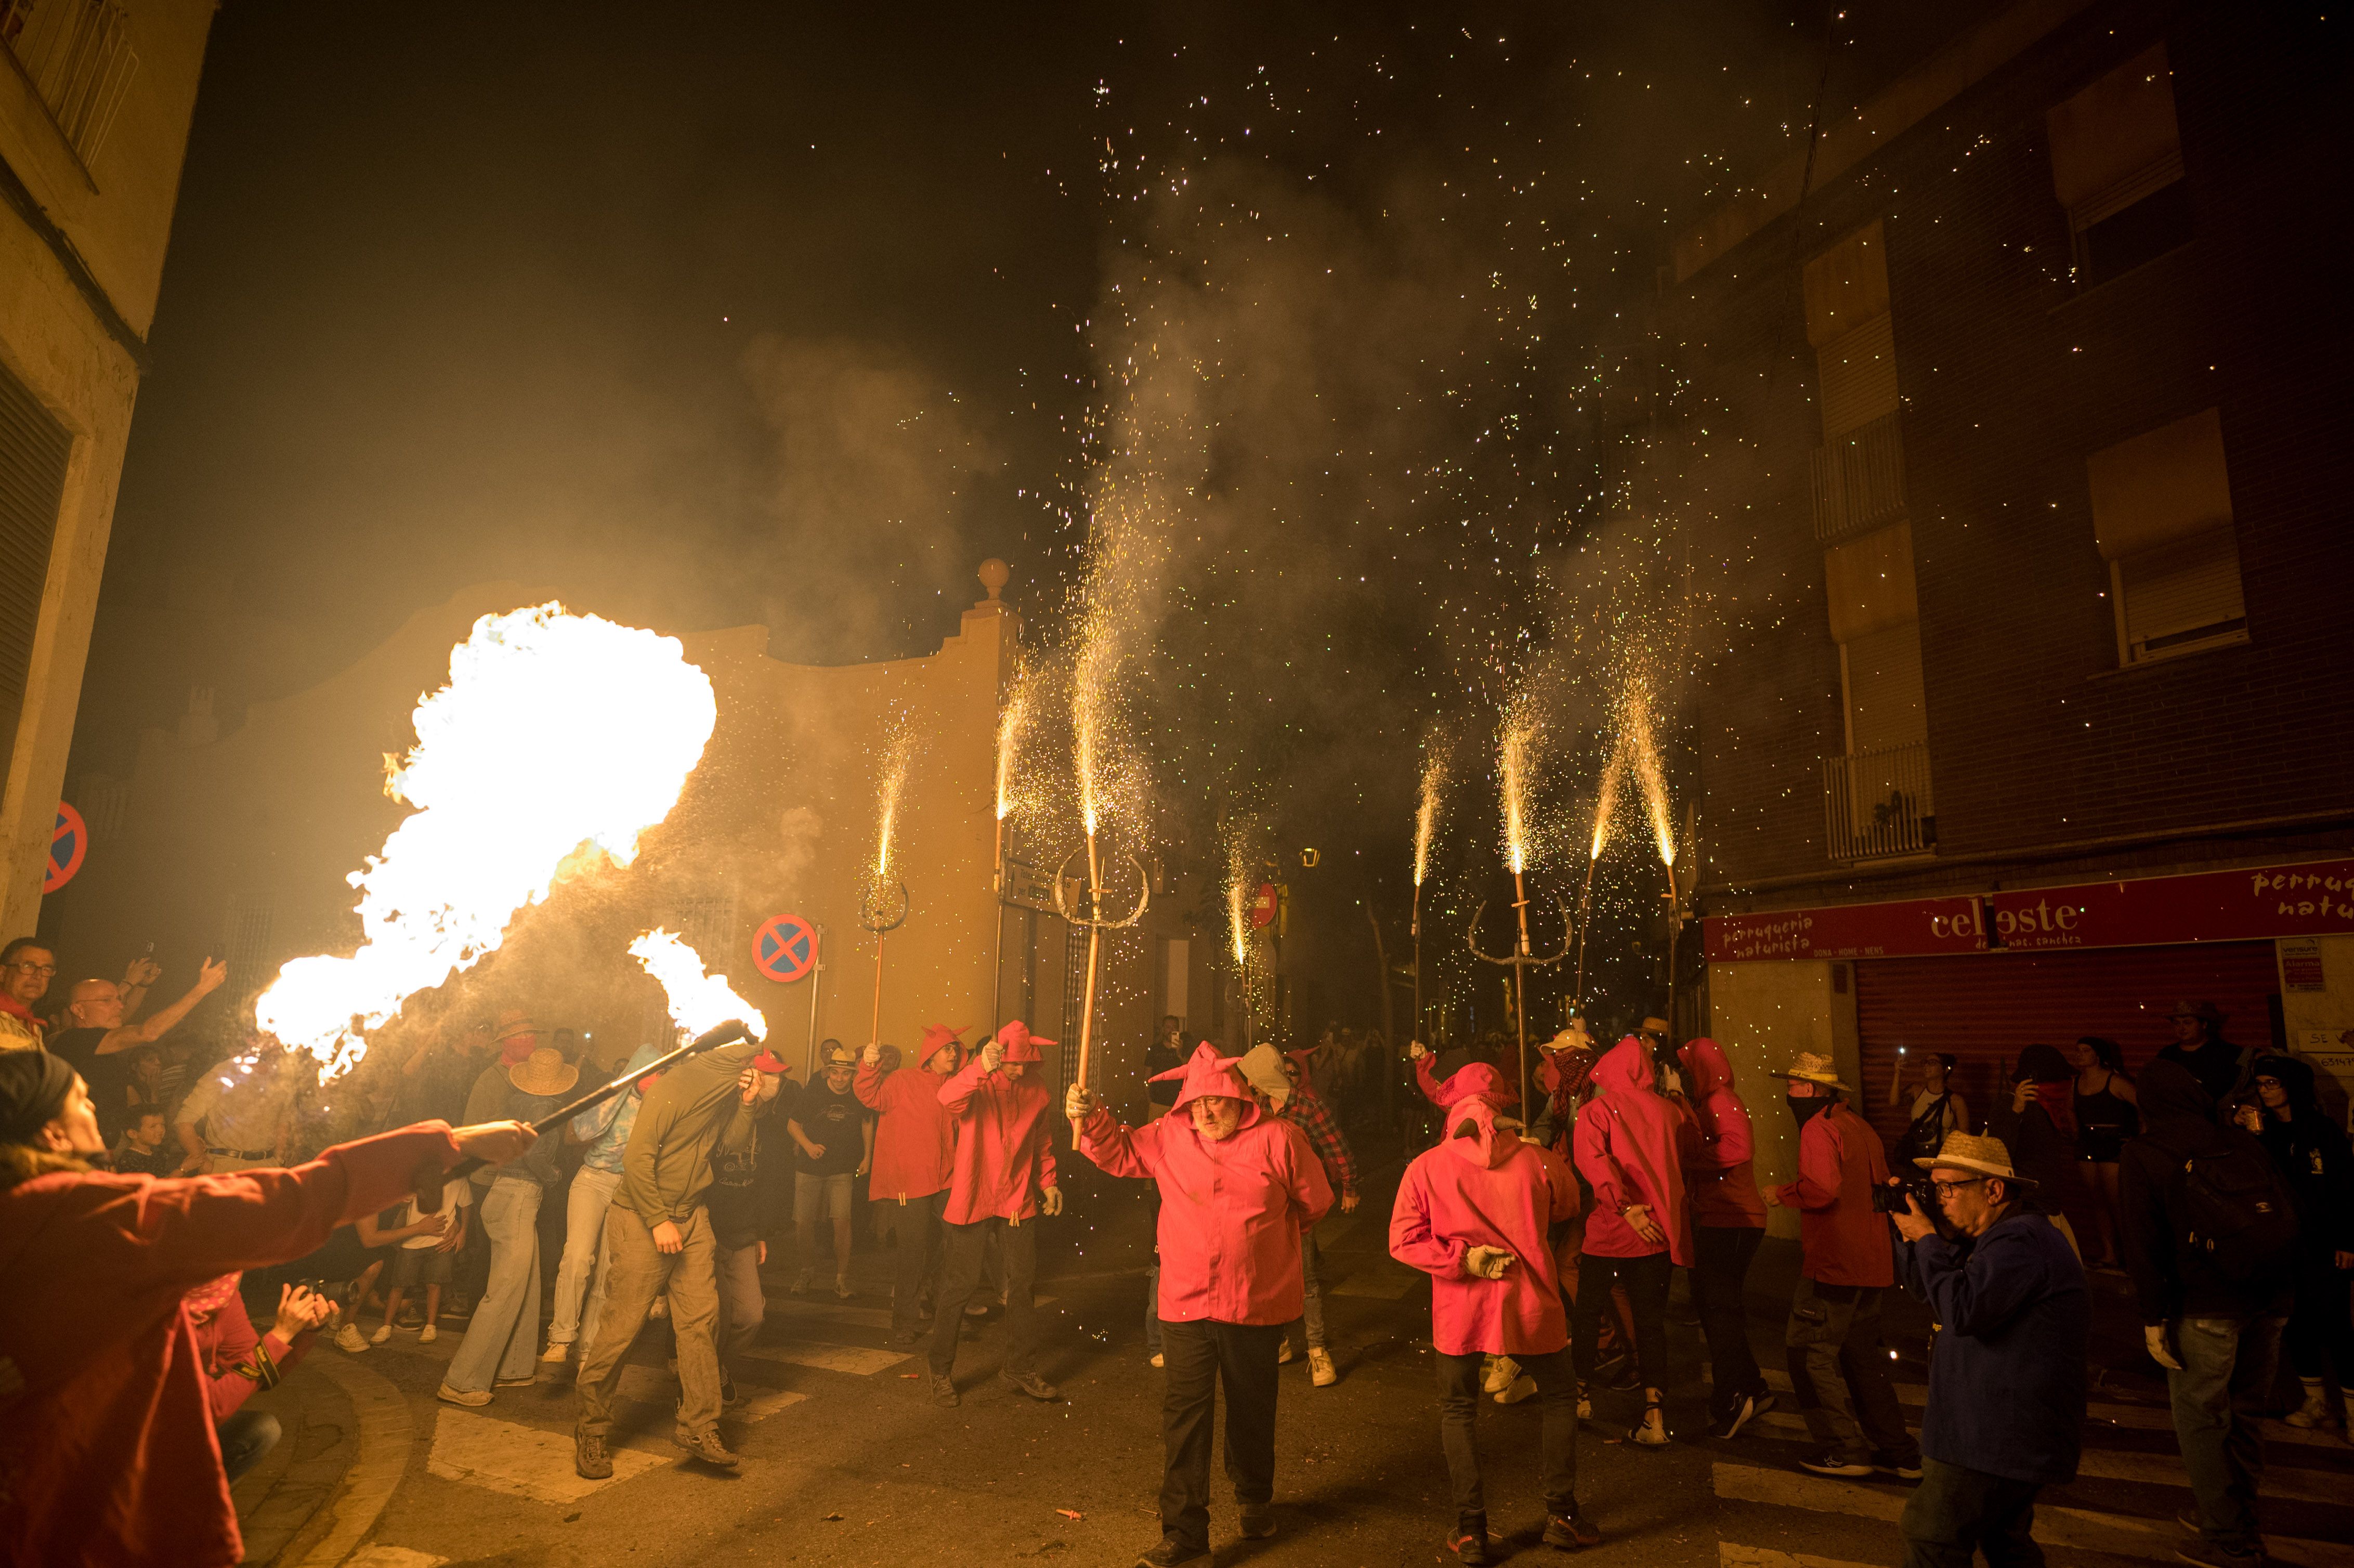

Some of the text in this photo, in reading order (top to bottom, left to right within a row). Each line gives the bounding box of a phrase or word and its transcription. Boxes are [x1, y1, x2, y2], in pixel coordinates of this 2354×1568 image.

[2278, 895, 2354, 920] natu
[1722, 912, 1813, 949] perruqueria
[2036, 932, 2082, 946] sanchez
[1736, 935, 1810, 959] naturista
[1814, 946, 1884, 957] DONA HOME NENS
[2310, 1034, 2327, 1043] SE
